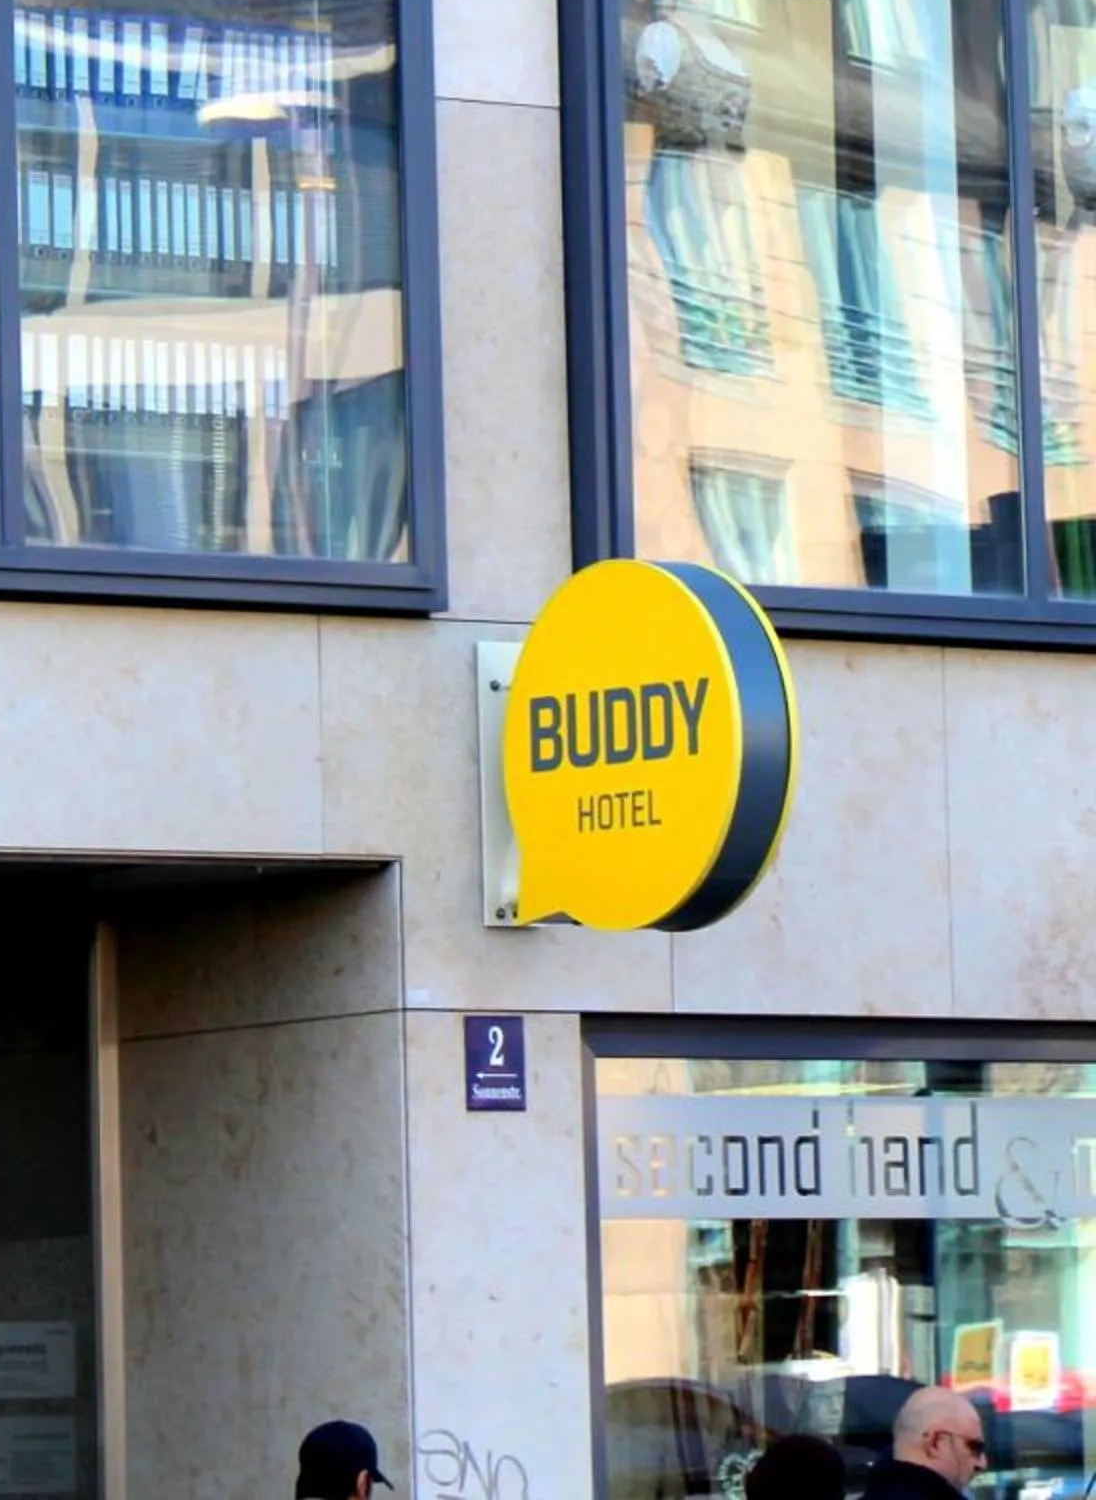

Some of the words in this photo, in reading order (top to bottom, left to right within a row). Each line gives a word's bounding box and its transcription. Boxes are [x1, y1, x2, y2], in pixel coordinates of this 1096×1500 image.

[530, 677, 709, 773] BUDDY
[577, 790, 662, 833] HOTEL
[488, 1025, 504, 1067] 2
[613, 1104, 821, 1197] second
[848, 1100, 980, 1198] hand
[995, 1137, 1068, 1232] &
